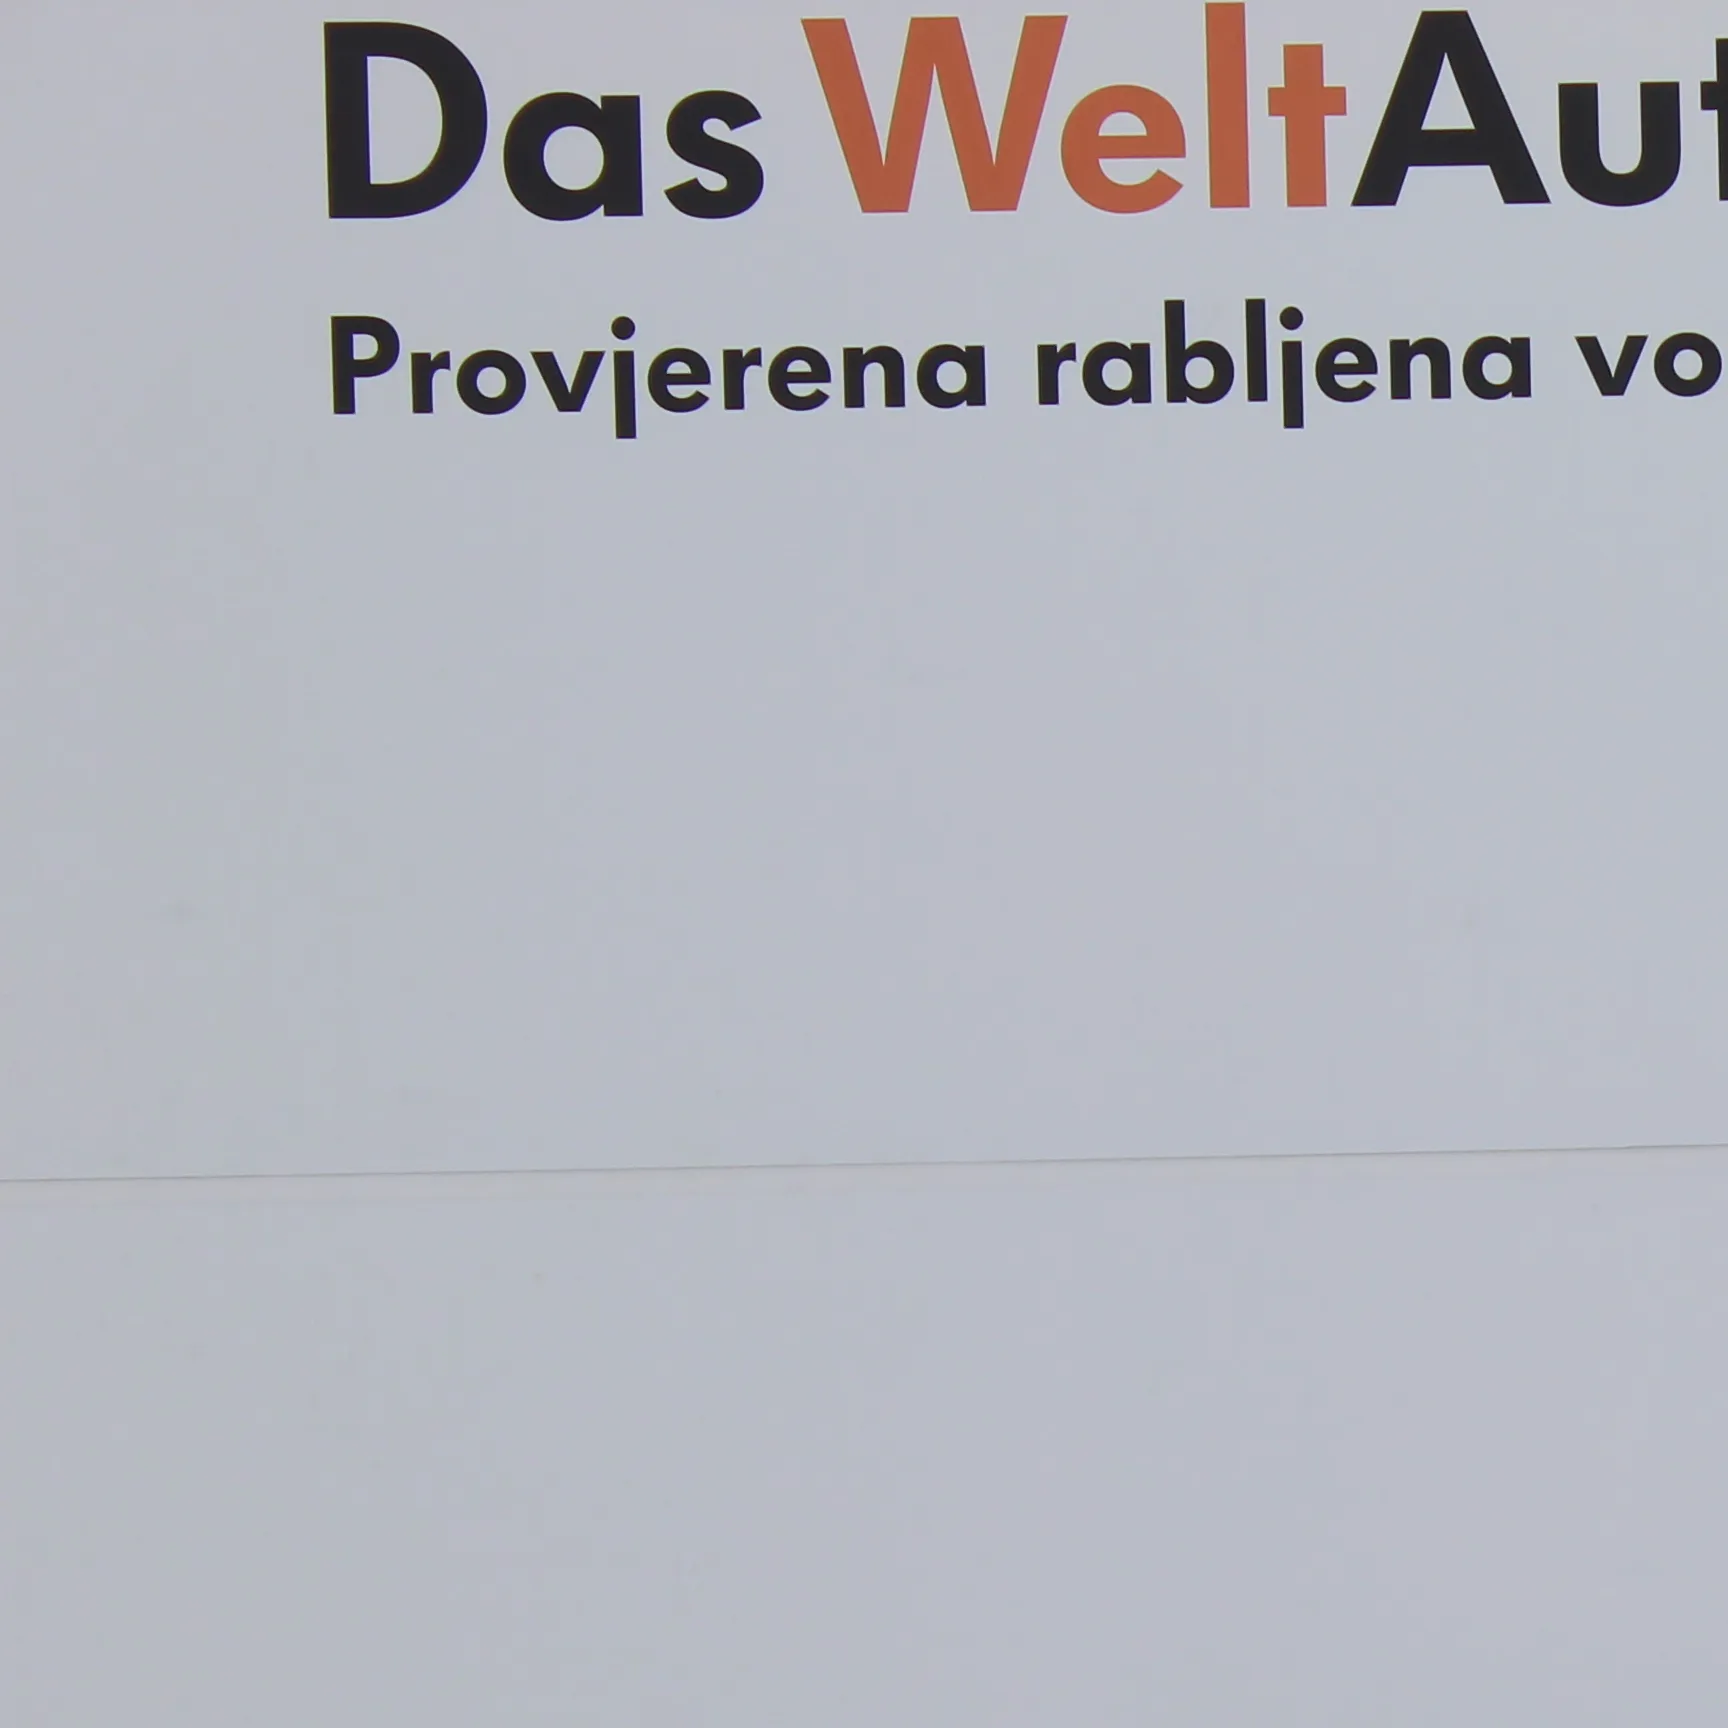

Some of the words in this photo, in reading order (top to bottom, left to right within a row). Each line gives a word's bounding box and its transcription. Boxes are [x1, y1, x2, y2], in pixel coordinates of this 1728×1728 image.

[324, 22, 765, 221] Das
[330, 315, 987, 440] Provjerena
[1037, 298, 1532, 429] rabljena
